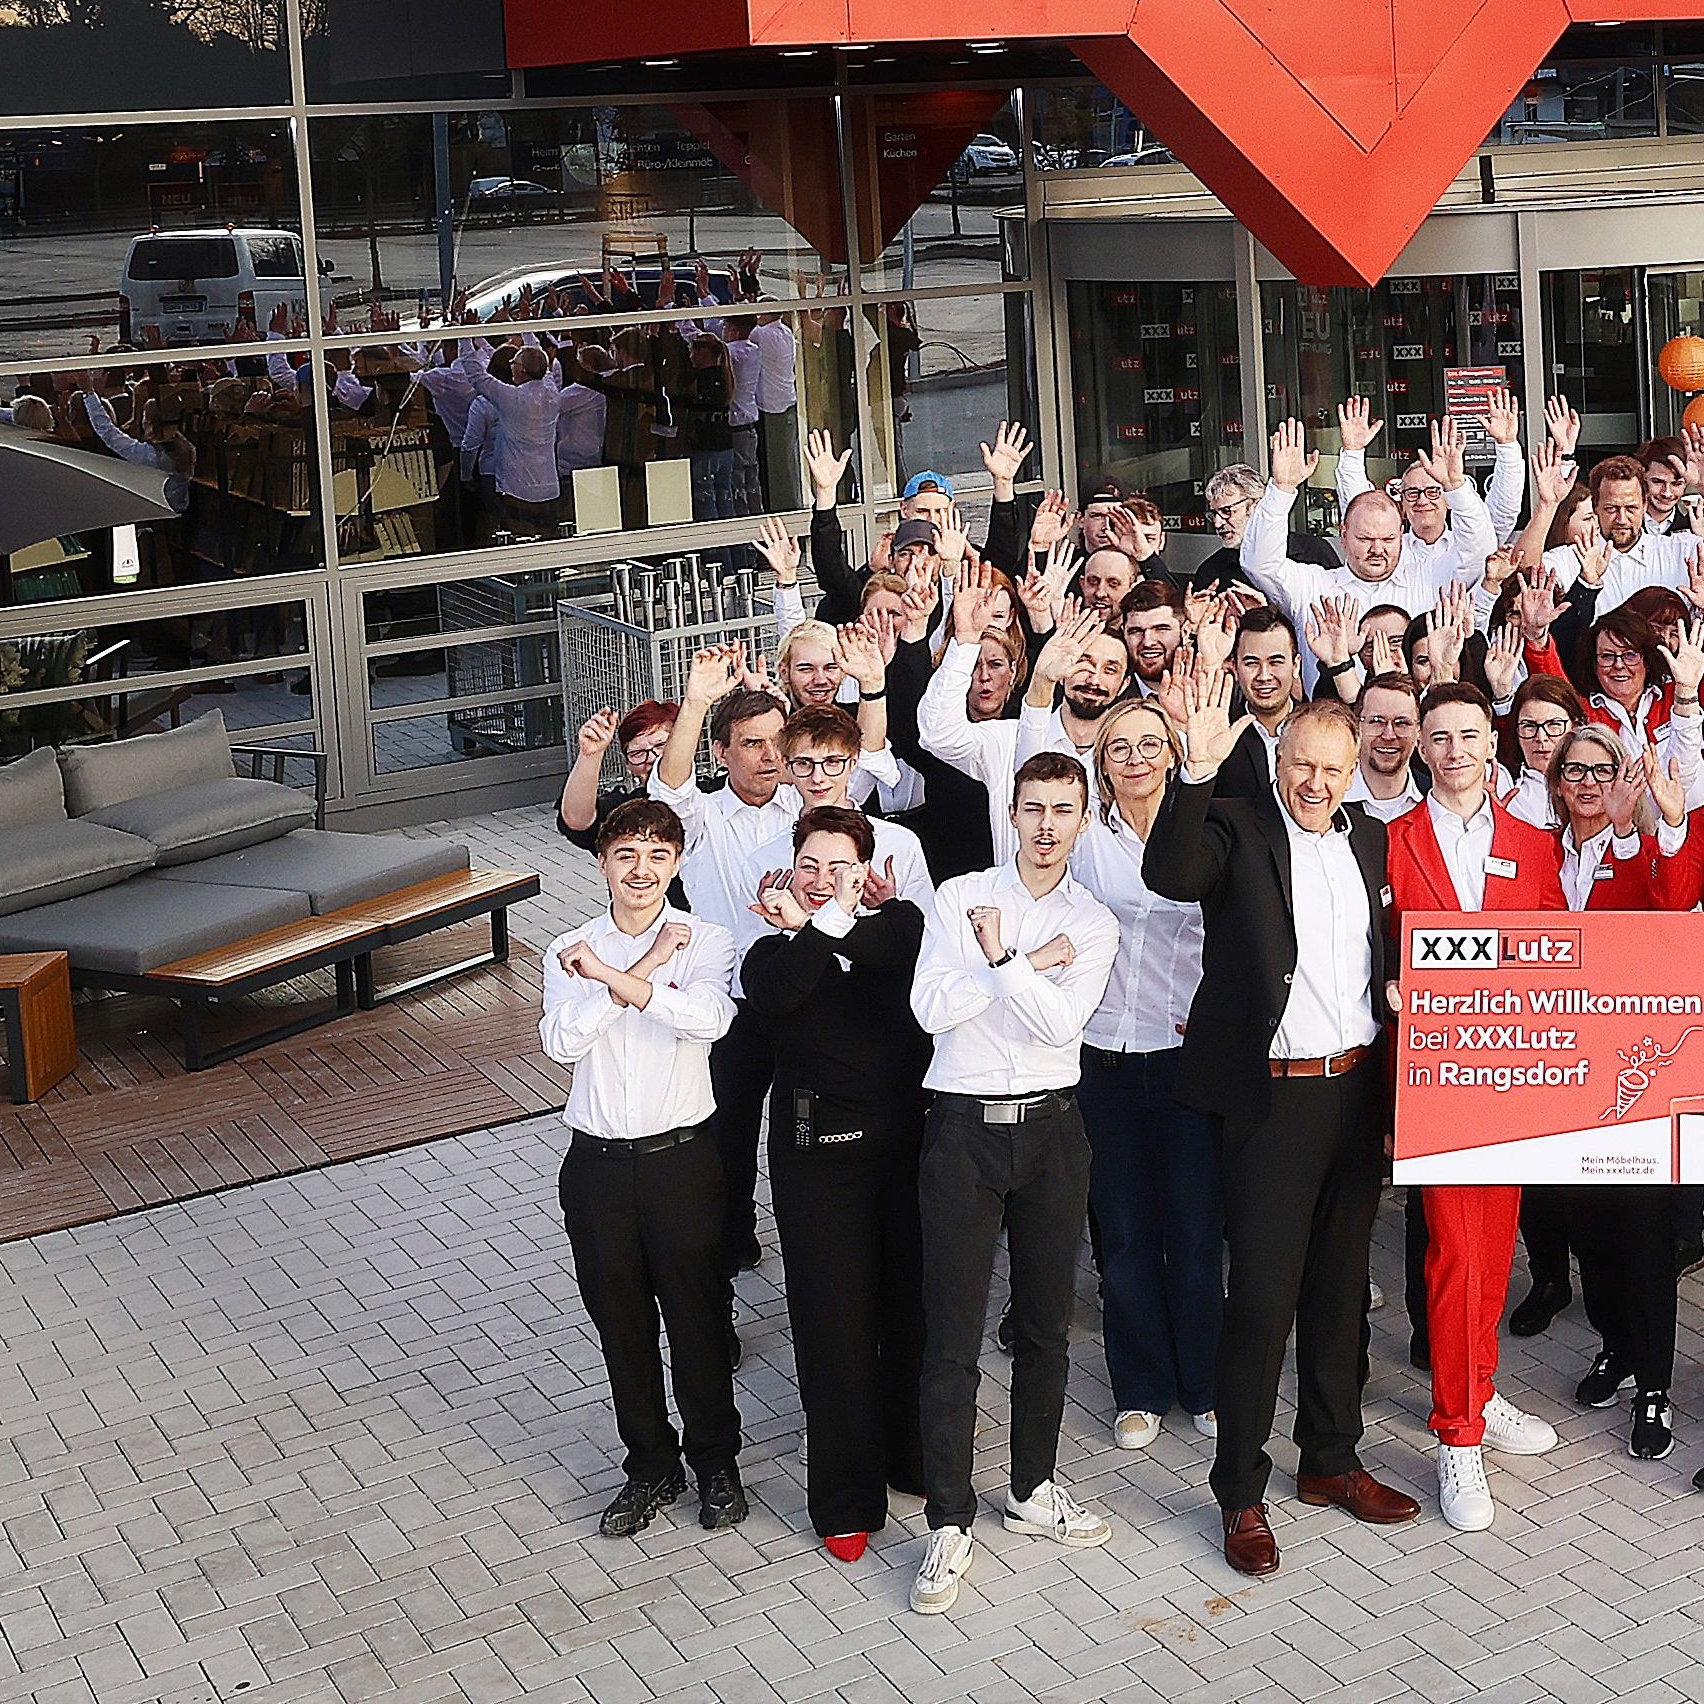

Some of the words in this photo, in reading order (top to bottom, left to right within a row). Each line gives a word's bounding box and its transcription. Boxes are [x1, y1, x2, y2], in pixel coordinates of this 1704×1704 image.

[883, 147, 918, 158] Küchen
[1420, 935, 1573, 962] XXXLutz
[1410, 989, 1522, 1015] Herzlich
[1527, 989, 1702, 1015] Willkommen
[1409, 1025, 1449, 1050] bei
[1455, 1025, 1577, 1050] XXXLutz
[1408, 1061, 1432, 1086] in
[1438, 1060, 1589, 1091] Rangsdorf
[1581, 1156, 1604, 1164] Mein
[1581, 1166, 1604, 1174] Mein
[1606, 1166, 1655, 1174] xxxlutz.de
